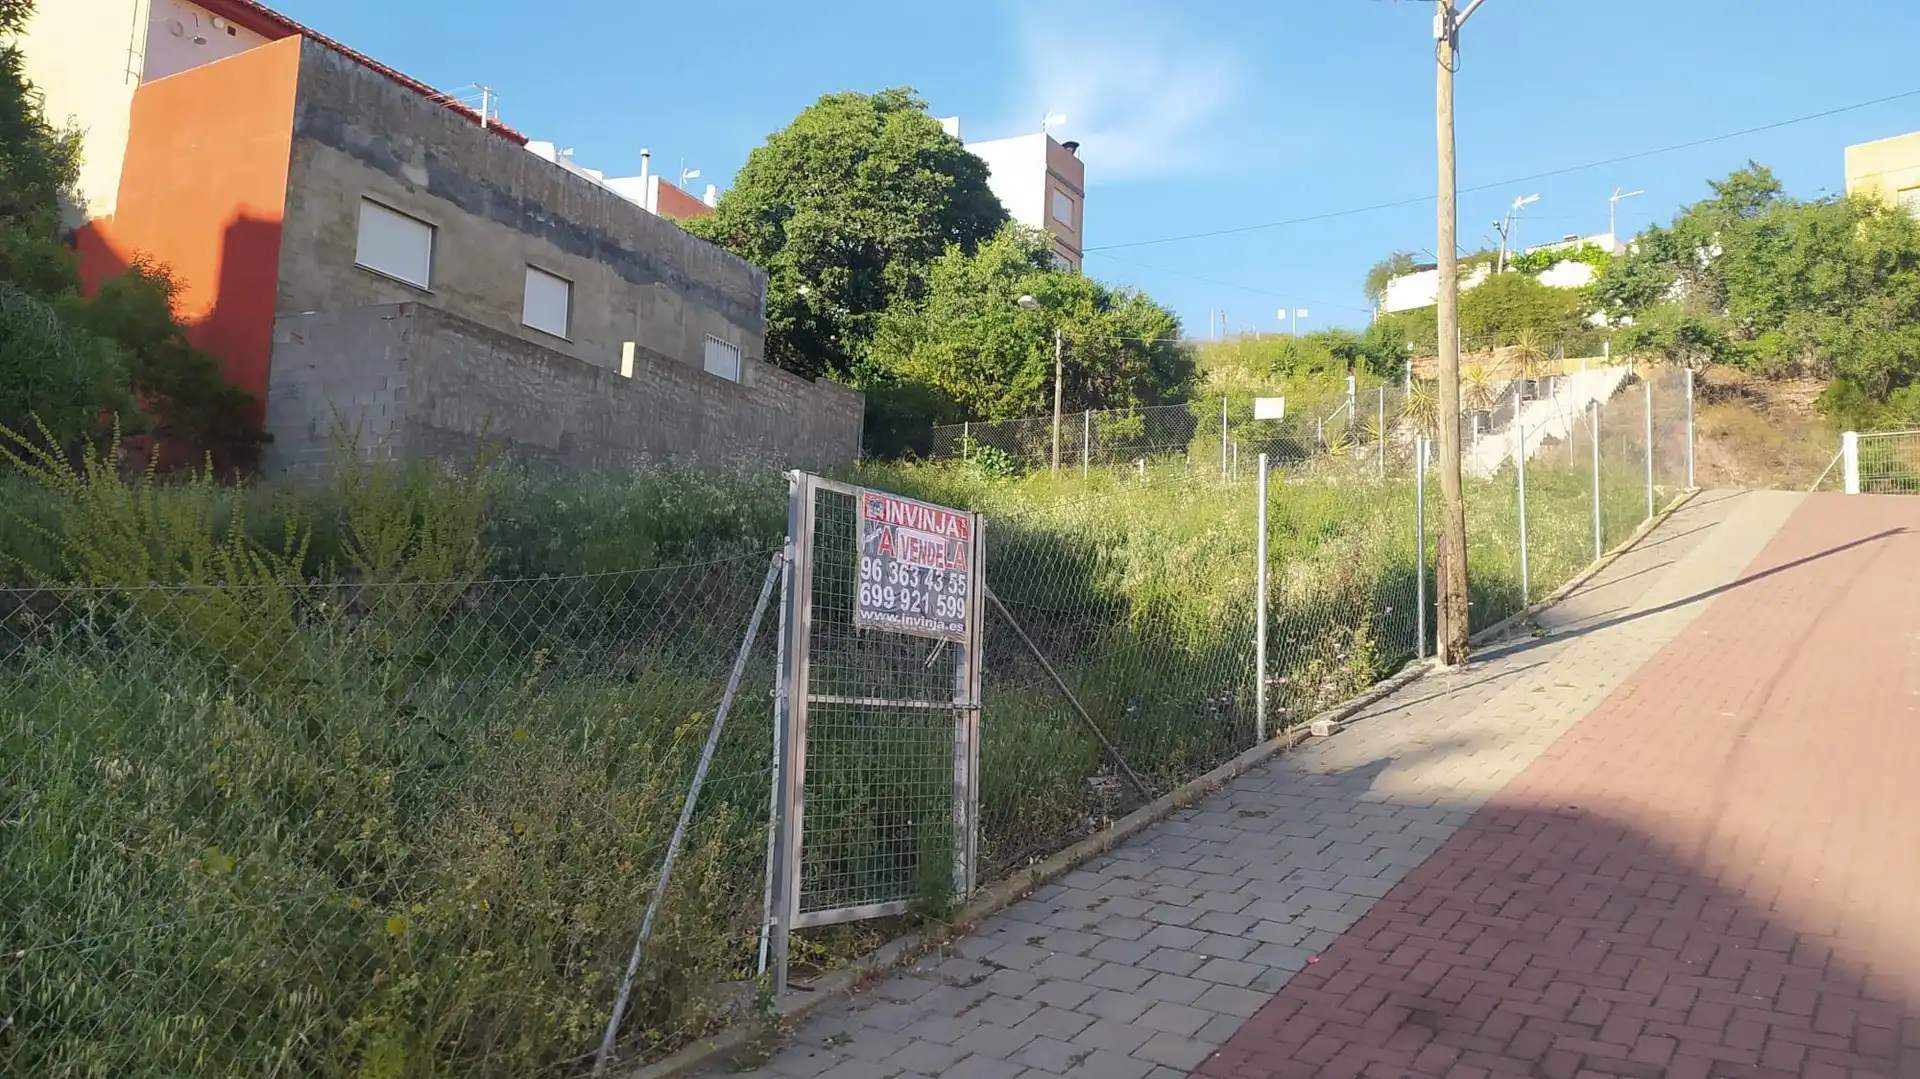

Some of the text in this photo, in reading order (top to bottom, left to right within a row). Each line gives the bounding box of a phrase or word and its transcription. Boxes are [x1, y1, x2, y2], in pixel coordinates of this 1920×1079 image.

[885, 499, 960, 538] INVINJA
[900, 534, 945, 569] VENDE
[861, 556, 967, 596] 96 363 43 55
[860, 582, 966, 620] 699 921 599
[860, 610, 964, 632] www.invinja.es
